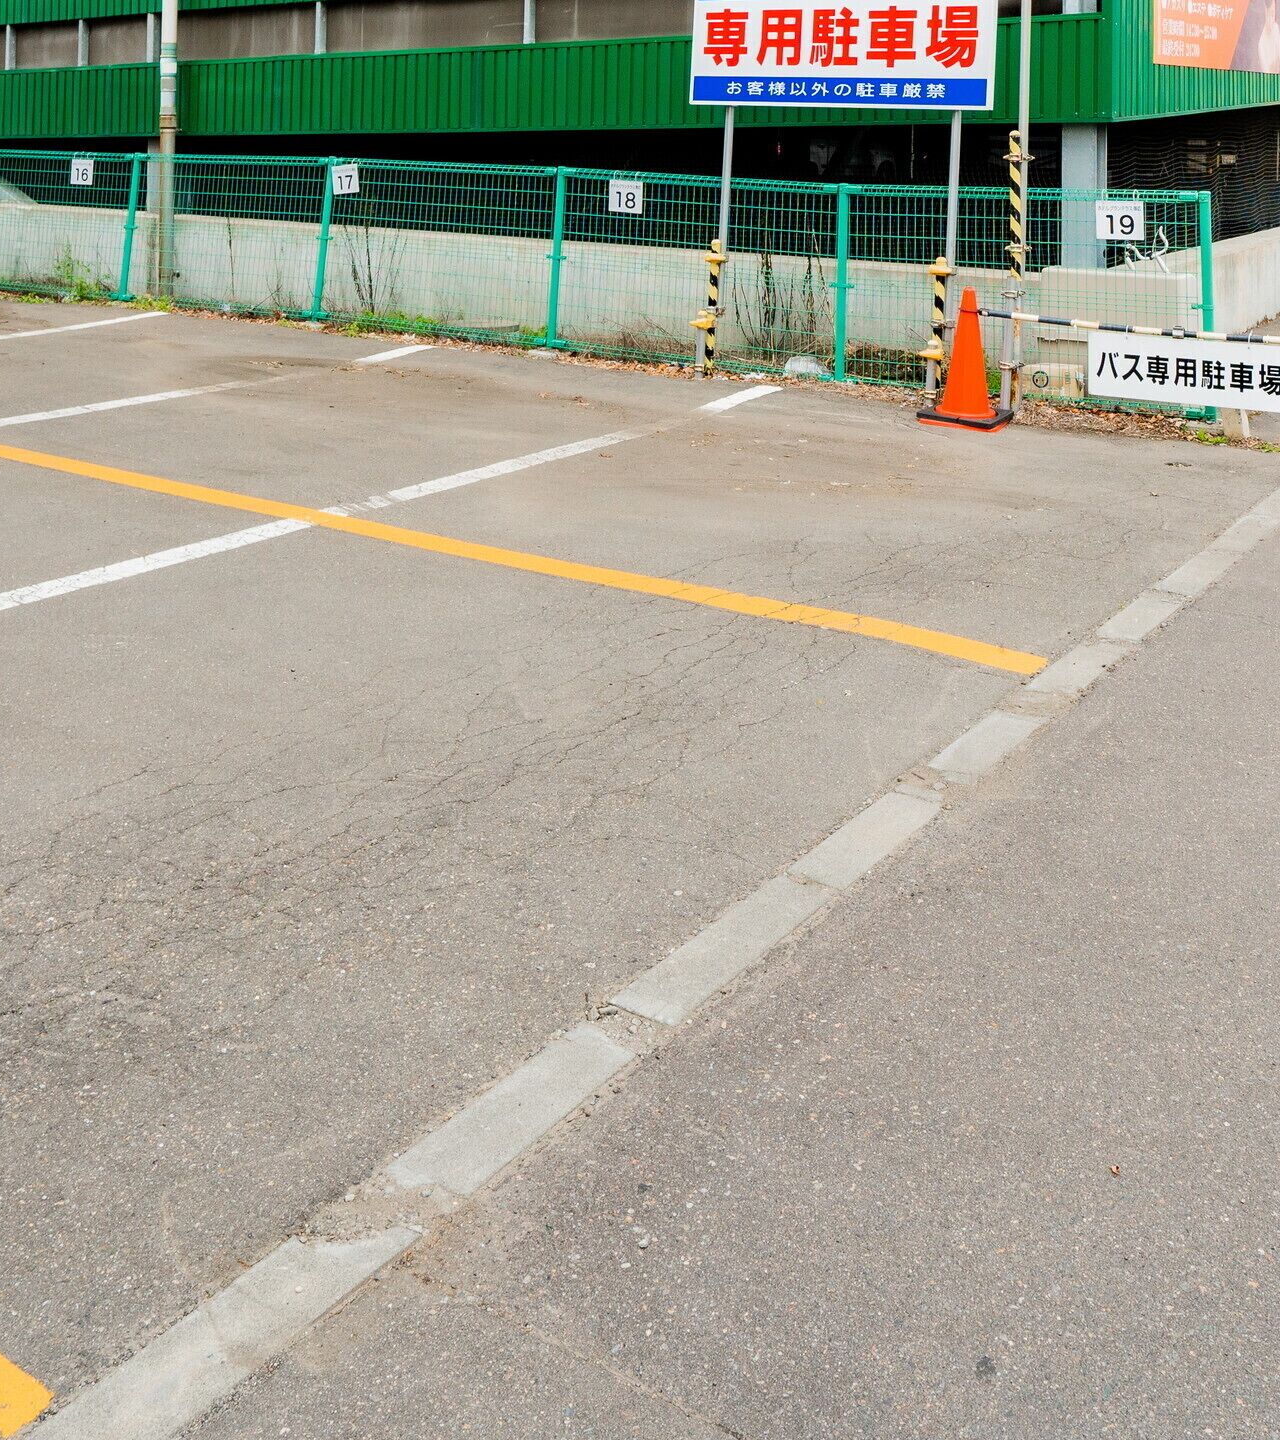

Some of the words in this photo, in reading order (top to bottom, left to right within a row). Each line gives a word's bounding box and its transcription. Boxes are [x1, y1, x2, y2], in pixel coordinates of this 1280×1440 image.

[703, 5, 979, 69] 専用駐車場
[726, 81, 947, 99] お客様以外の駐車厳禁
[75, 168, 88, 181] 16
[336, 174, 353, 191] 17
[615, 191, 636, 209] 18
[1105, 214, 1135, 236] 19
